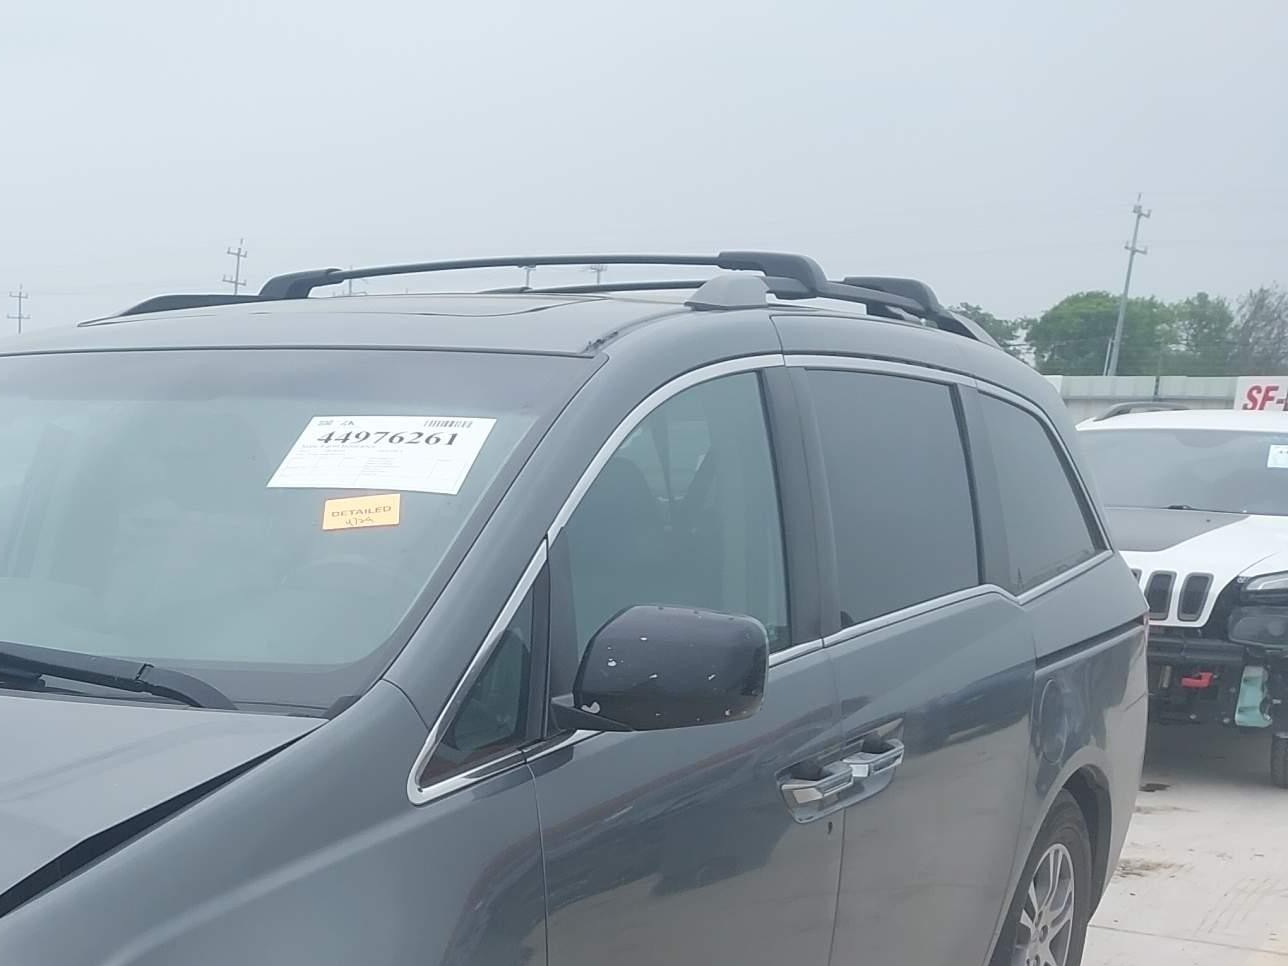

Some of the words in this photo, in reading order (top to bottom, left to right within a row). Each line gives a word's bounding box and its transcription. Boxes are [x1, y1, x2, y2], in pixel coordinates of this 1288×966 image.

[1242, 385, 1288, 411] SF-
[317, 430, 458, 446] 44976261
[331, 505, 392, 518] DETAILED
